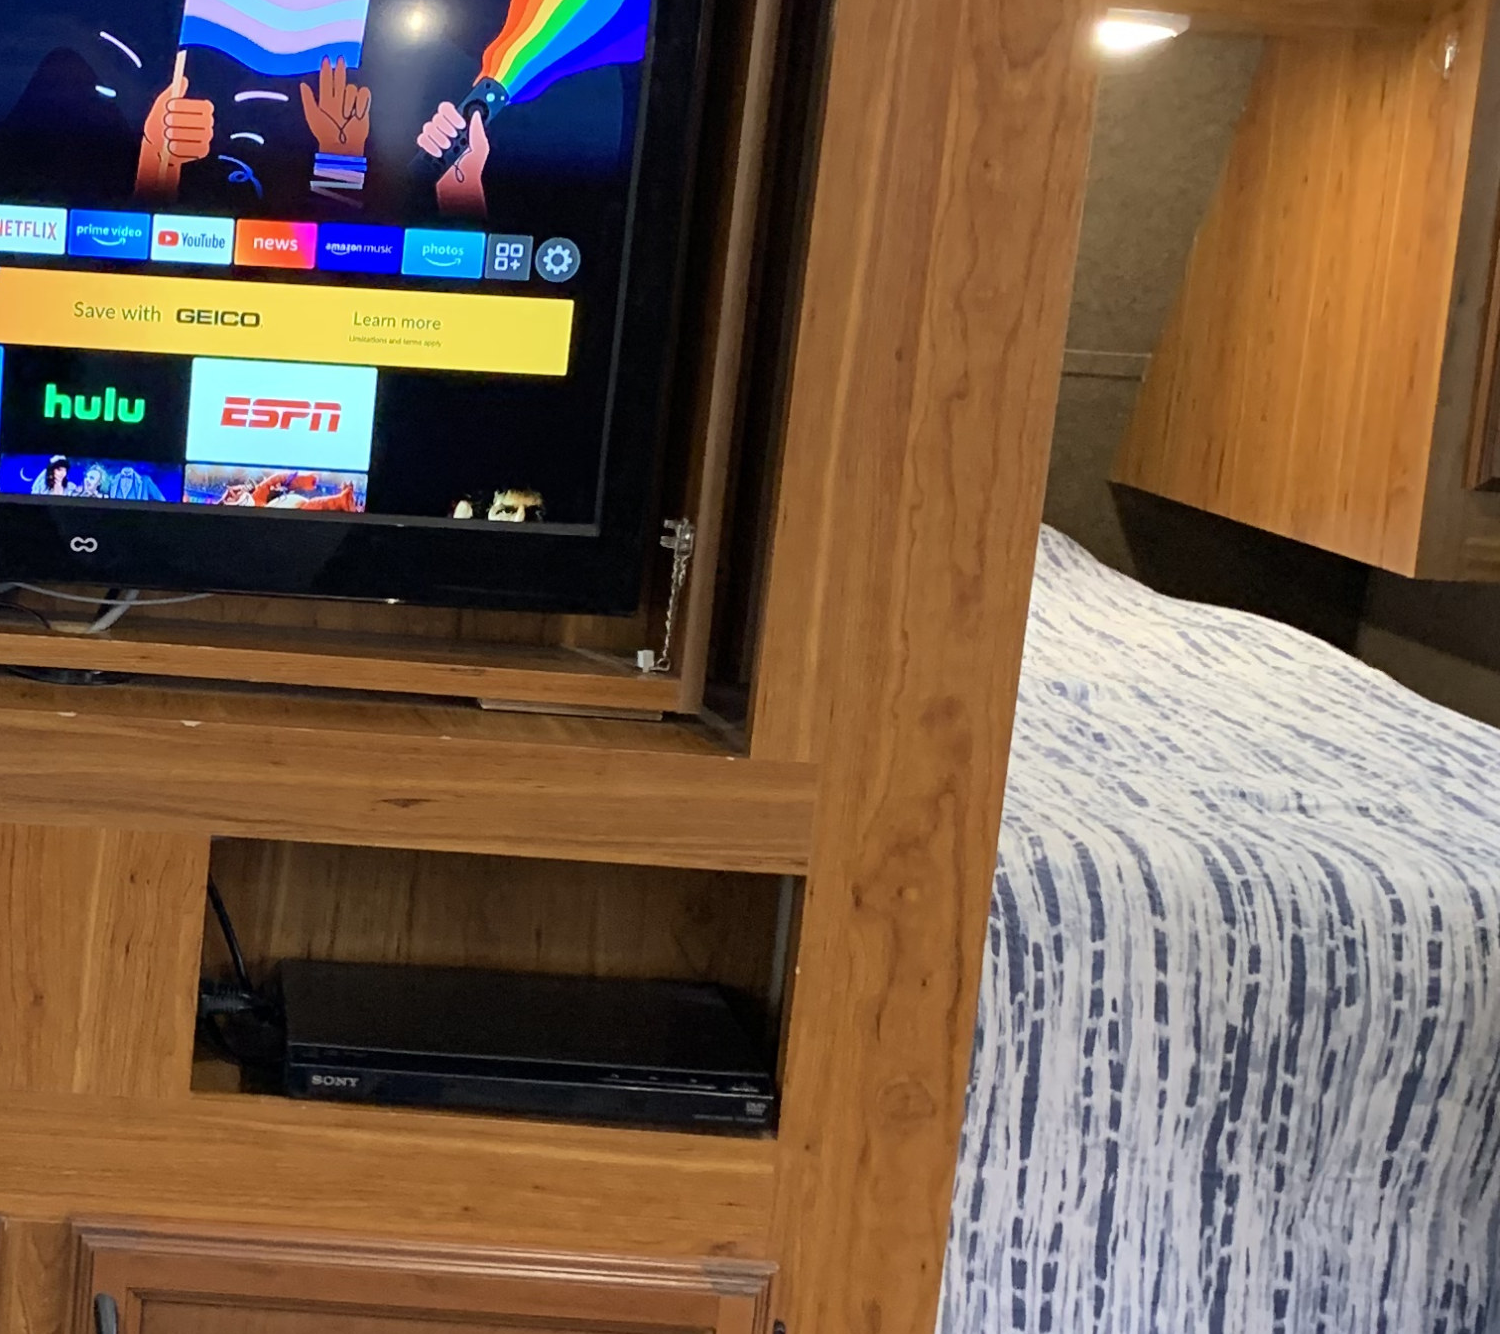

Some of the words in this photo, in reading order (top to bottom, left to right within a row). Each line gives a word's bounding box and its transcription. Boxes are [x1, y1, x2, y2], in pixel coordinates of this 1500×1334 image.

[76, 223, 109, 237] prime
[111, 225, 143, 238] video
[181, 232, 226, 250] YouTube
[253, 236, 298, 252] news
[325, 242, 362, 253] amazon
[363, 244, 393, 255] music
[422, 243, 464, 258] photos
[73, 301, 116, 320] Save
[122, 304, 162, 323] with
[175, 308, 262, 328] GEICO
[353, 311, 396, 328] Learn
[401, 317, 442, 331] more
[423, 340, 442, 348] apply
[44, 384, 145, 424] hulu
[220, 397, 342, 433] ESPN
[311, 1074, 360, 1087] SONY
